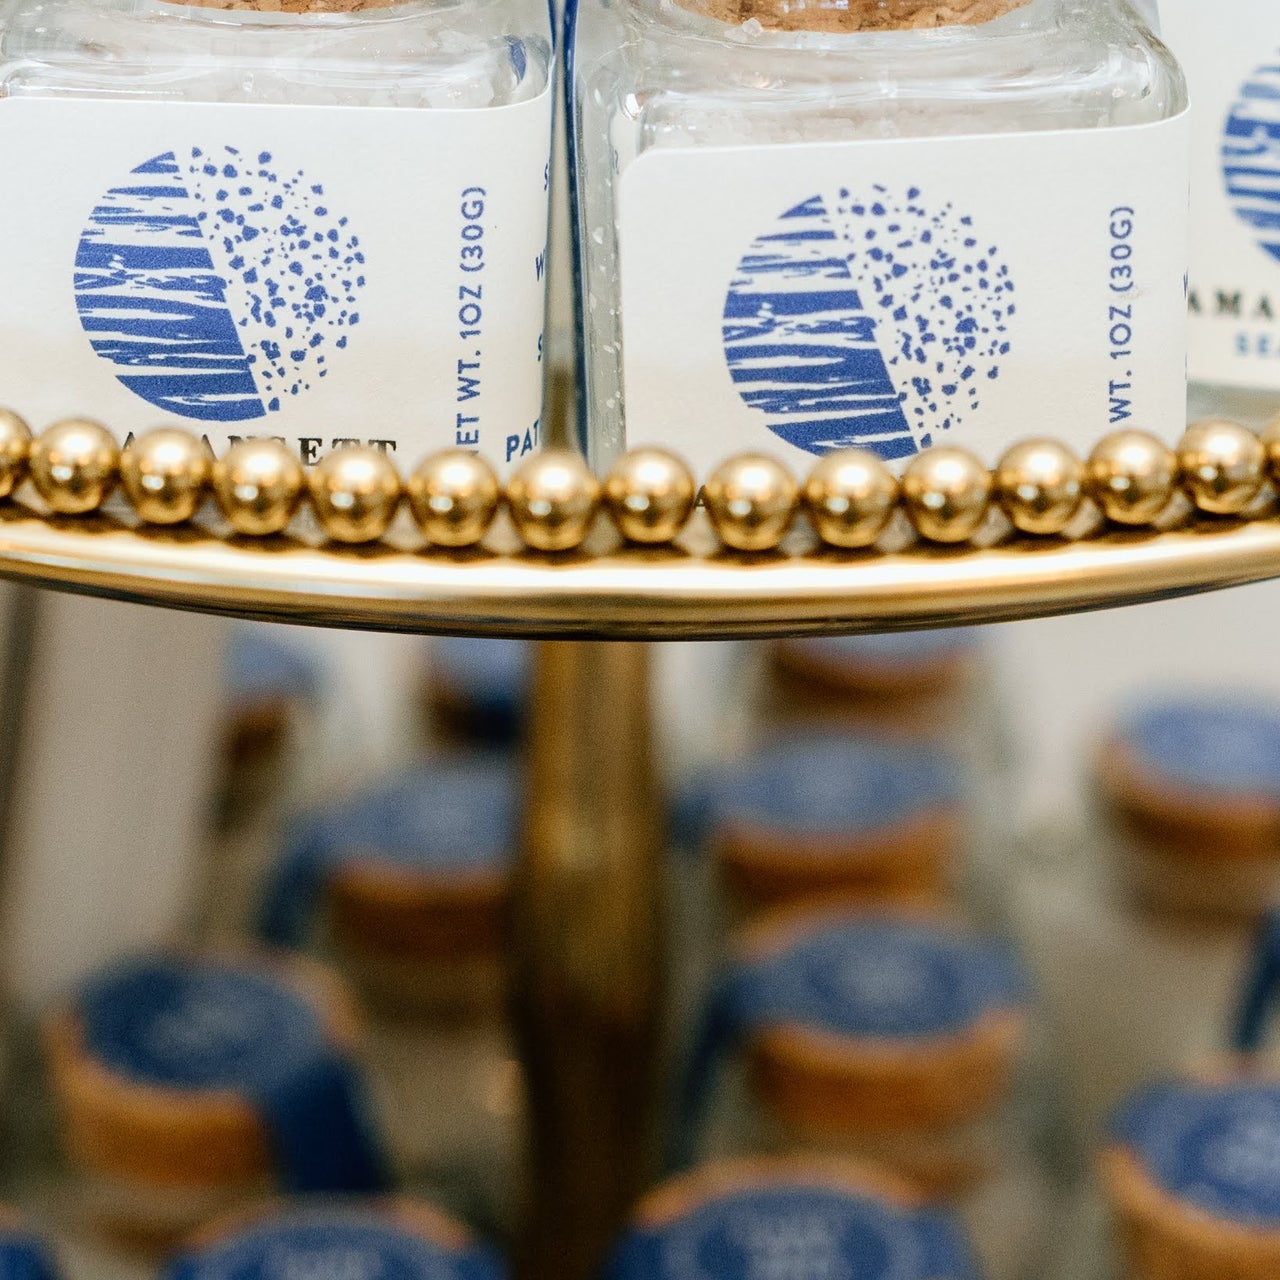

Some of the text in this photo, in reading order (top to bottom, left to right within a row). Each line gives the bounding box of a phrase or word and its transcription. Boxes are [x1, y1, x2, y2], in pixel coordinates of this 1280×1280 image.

[458, 186, 487, 272] (30G)
[458, 285, 482, 340] 1OZ
[1108, 206, 1134, 423] WT. 1OZ (30G)
[457, 350, 481, 401] WT.
